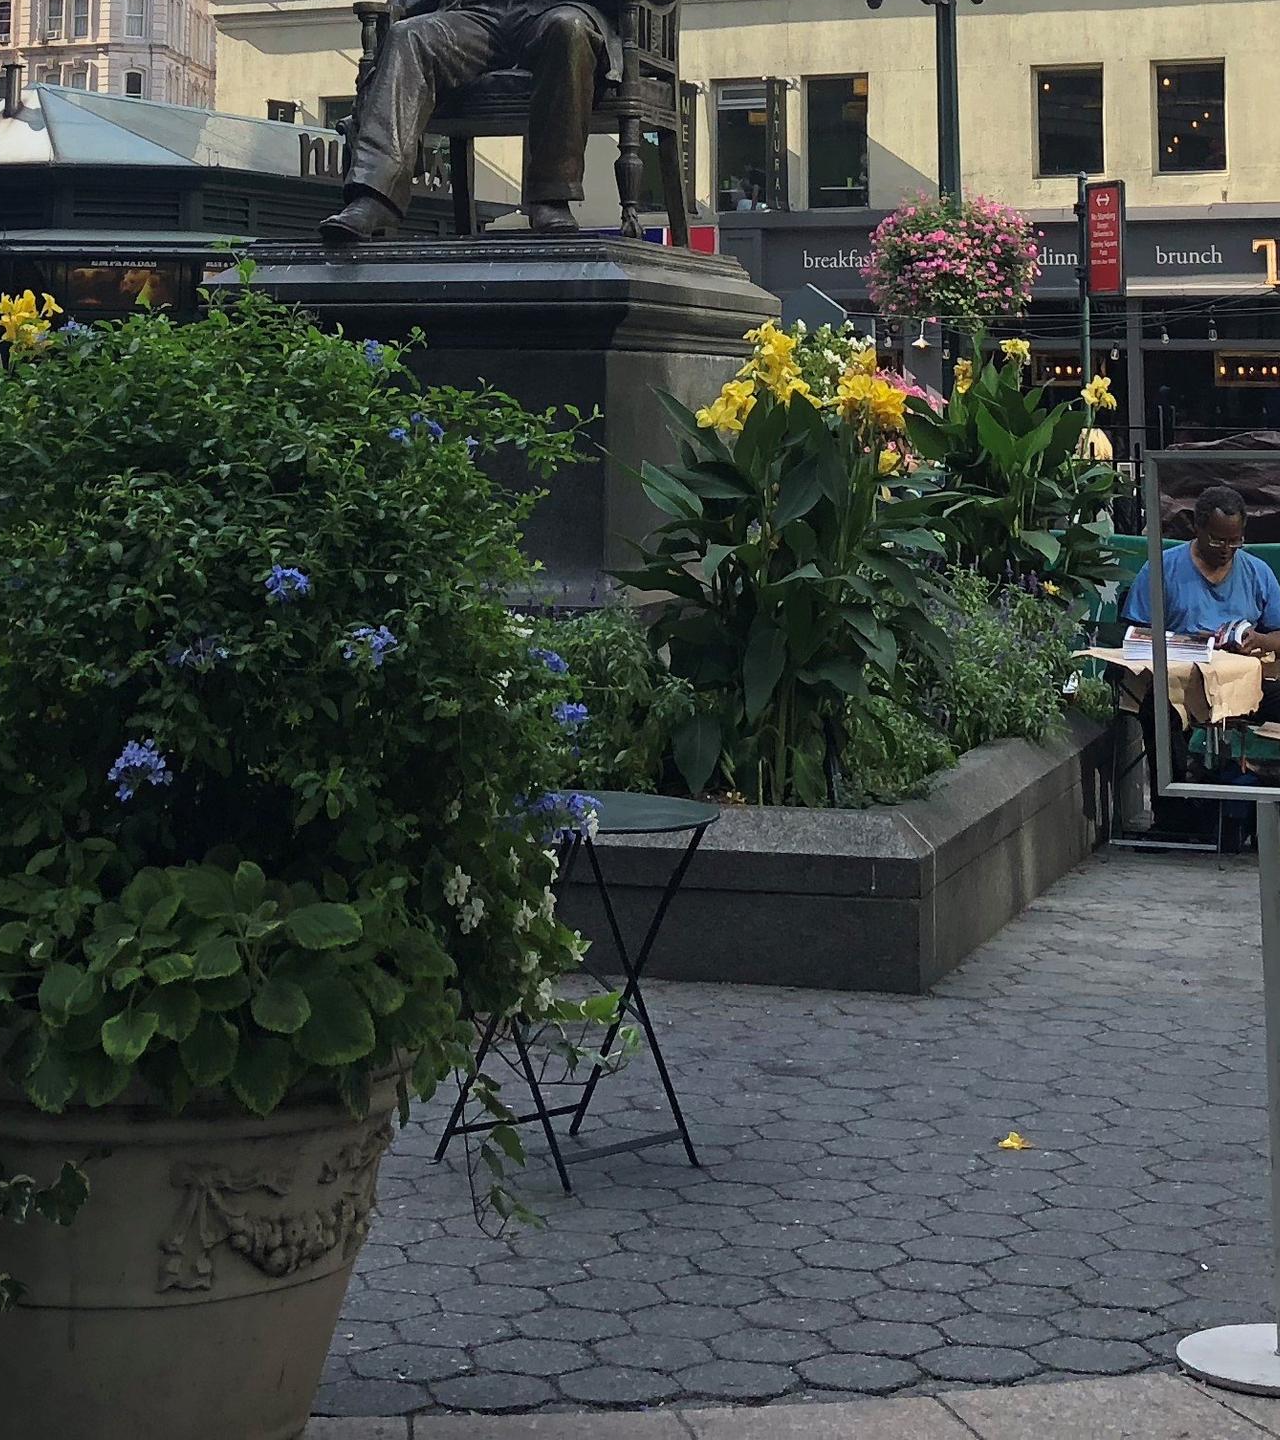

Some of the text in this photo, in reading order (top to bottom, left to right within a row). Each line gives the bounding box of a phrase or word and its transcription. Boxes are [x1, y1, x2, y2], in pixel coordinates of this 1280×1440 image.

[773, 83, 783, 210] NATURAL
[1037, 247, 1079, 266] dinn
[1155, 244, 1222, 266] brunch
